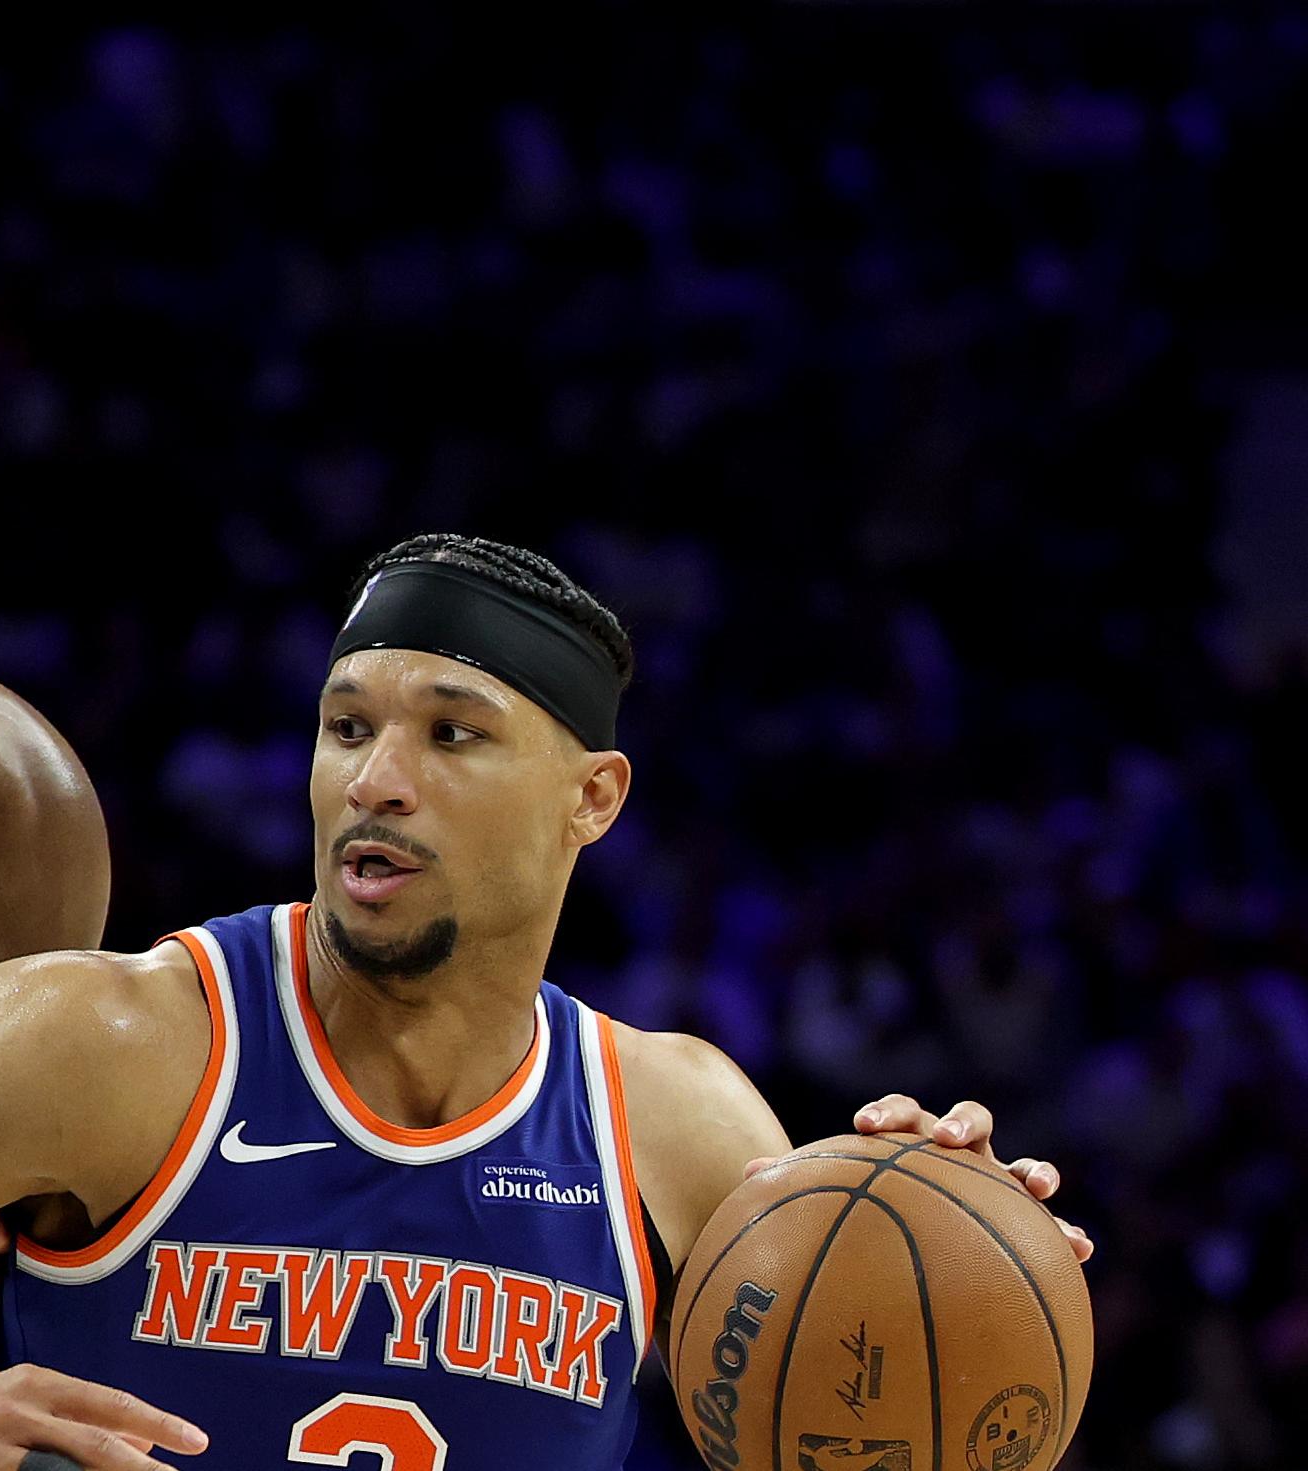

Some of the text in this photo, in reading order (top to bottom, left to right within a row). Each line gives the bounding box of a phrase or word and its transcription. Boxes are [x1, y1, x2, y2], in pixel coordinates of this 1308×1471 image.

[483, 1164, 547, 1179] experience
[481, 1176, 600, 1204] abu dhabi
[131, 1239, 624, 1409] NEW YORK
